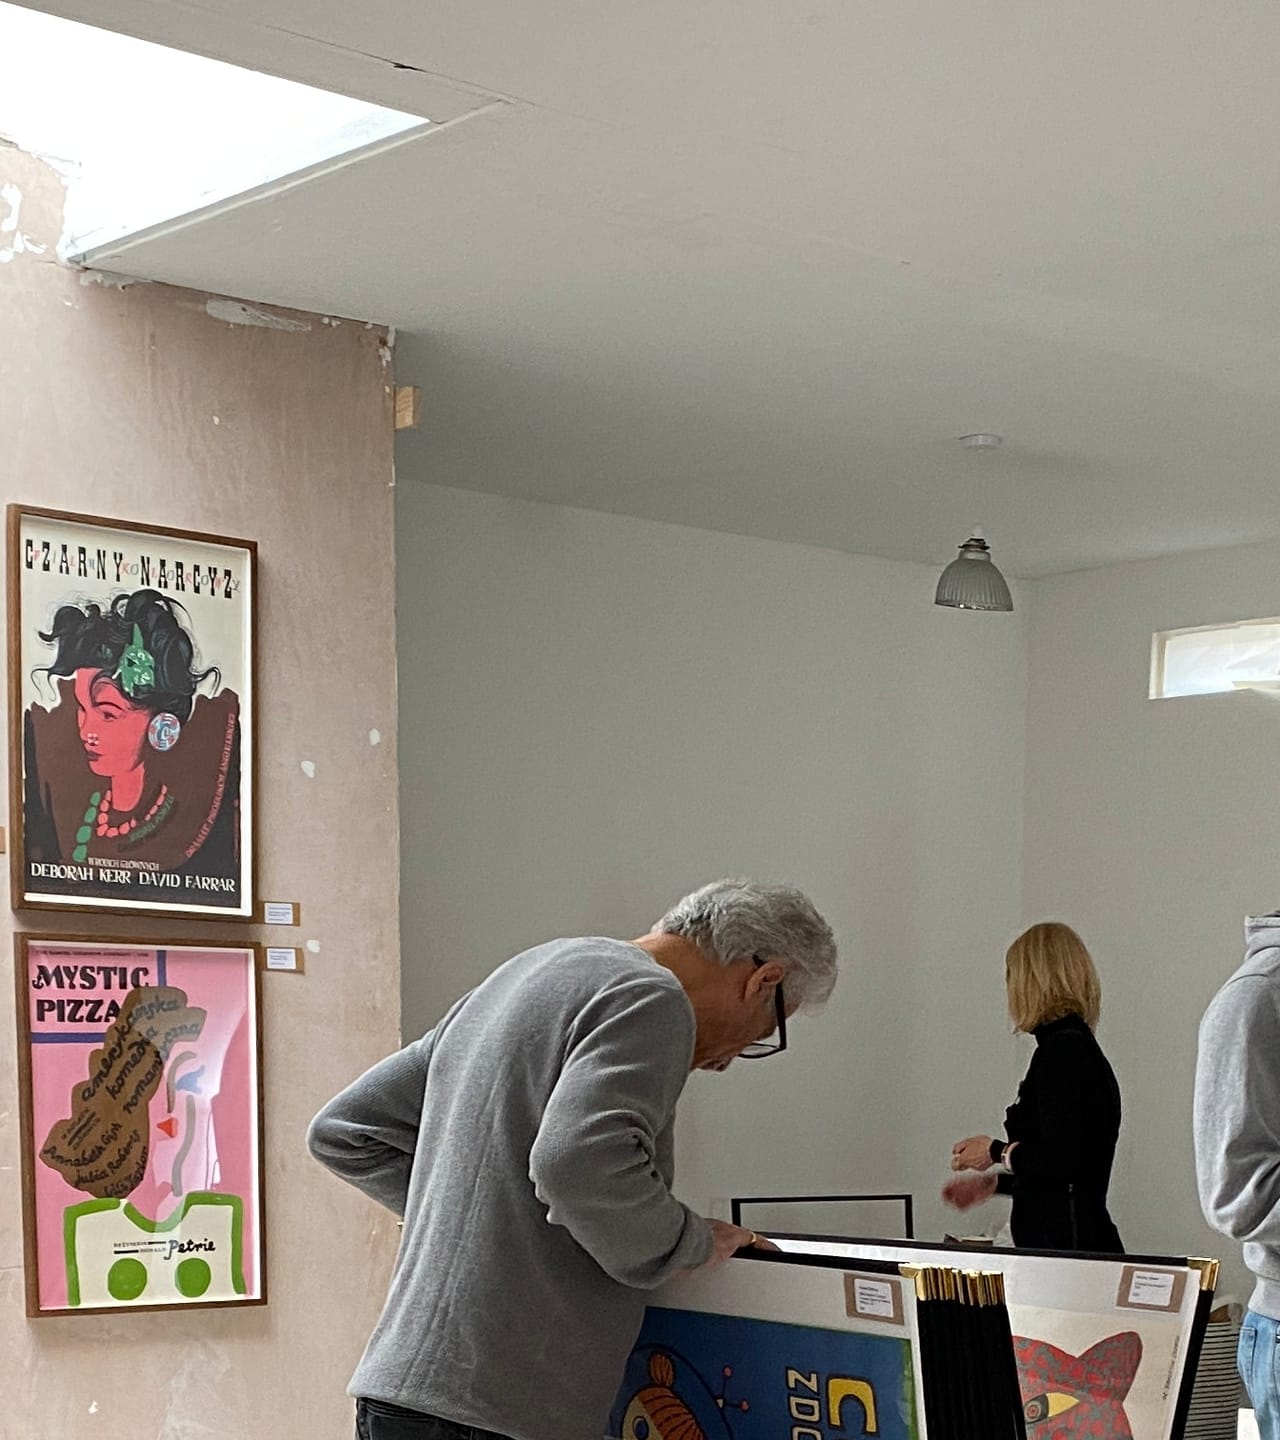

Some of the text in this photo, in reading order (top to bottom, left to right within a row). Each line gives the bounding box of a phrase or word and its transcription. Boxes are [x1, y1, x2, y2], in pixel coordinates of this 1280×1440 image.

[25, 539, 123, 582] CZARNY
[140, 555, 232, 599] NARCYZ
[31, 862, 235, 892] DEBORAH KERR DAVID FARRAR
[32, 965, 149, 990] MYSTIC
[36, 999, 120, 1023] PIZZA
[106, 1027, 158, 1100] komedia
[164, 1238, 216, 1260] Petrie
